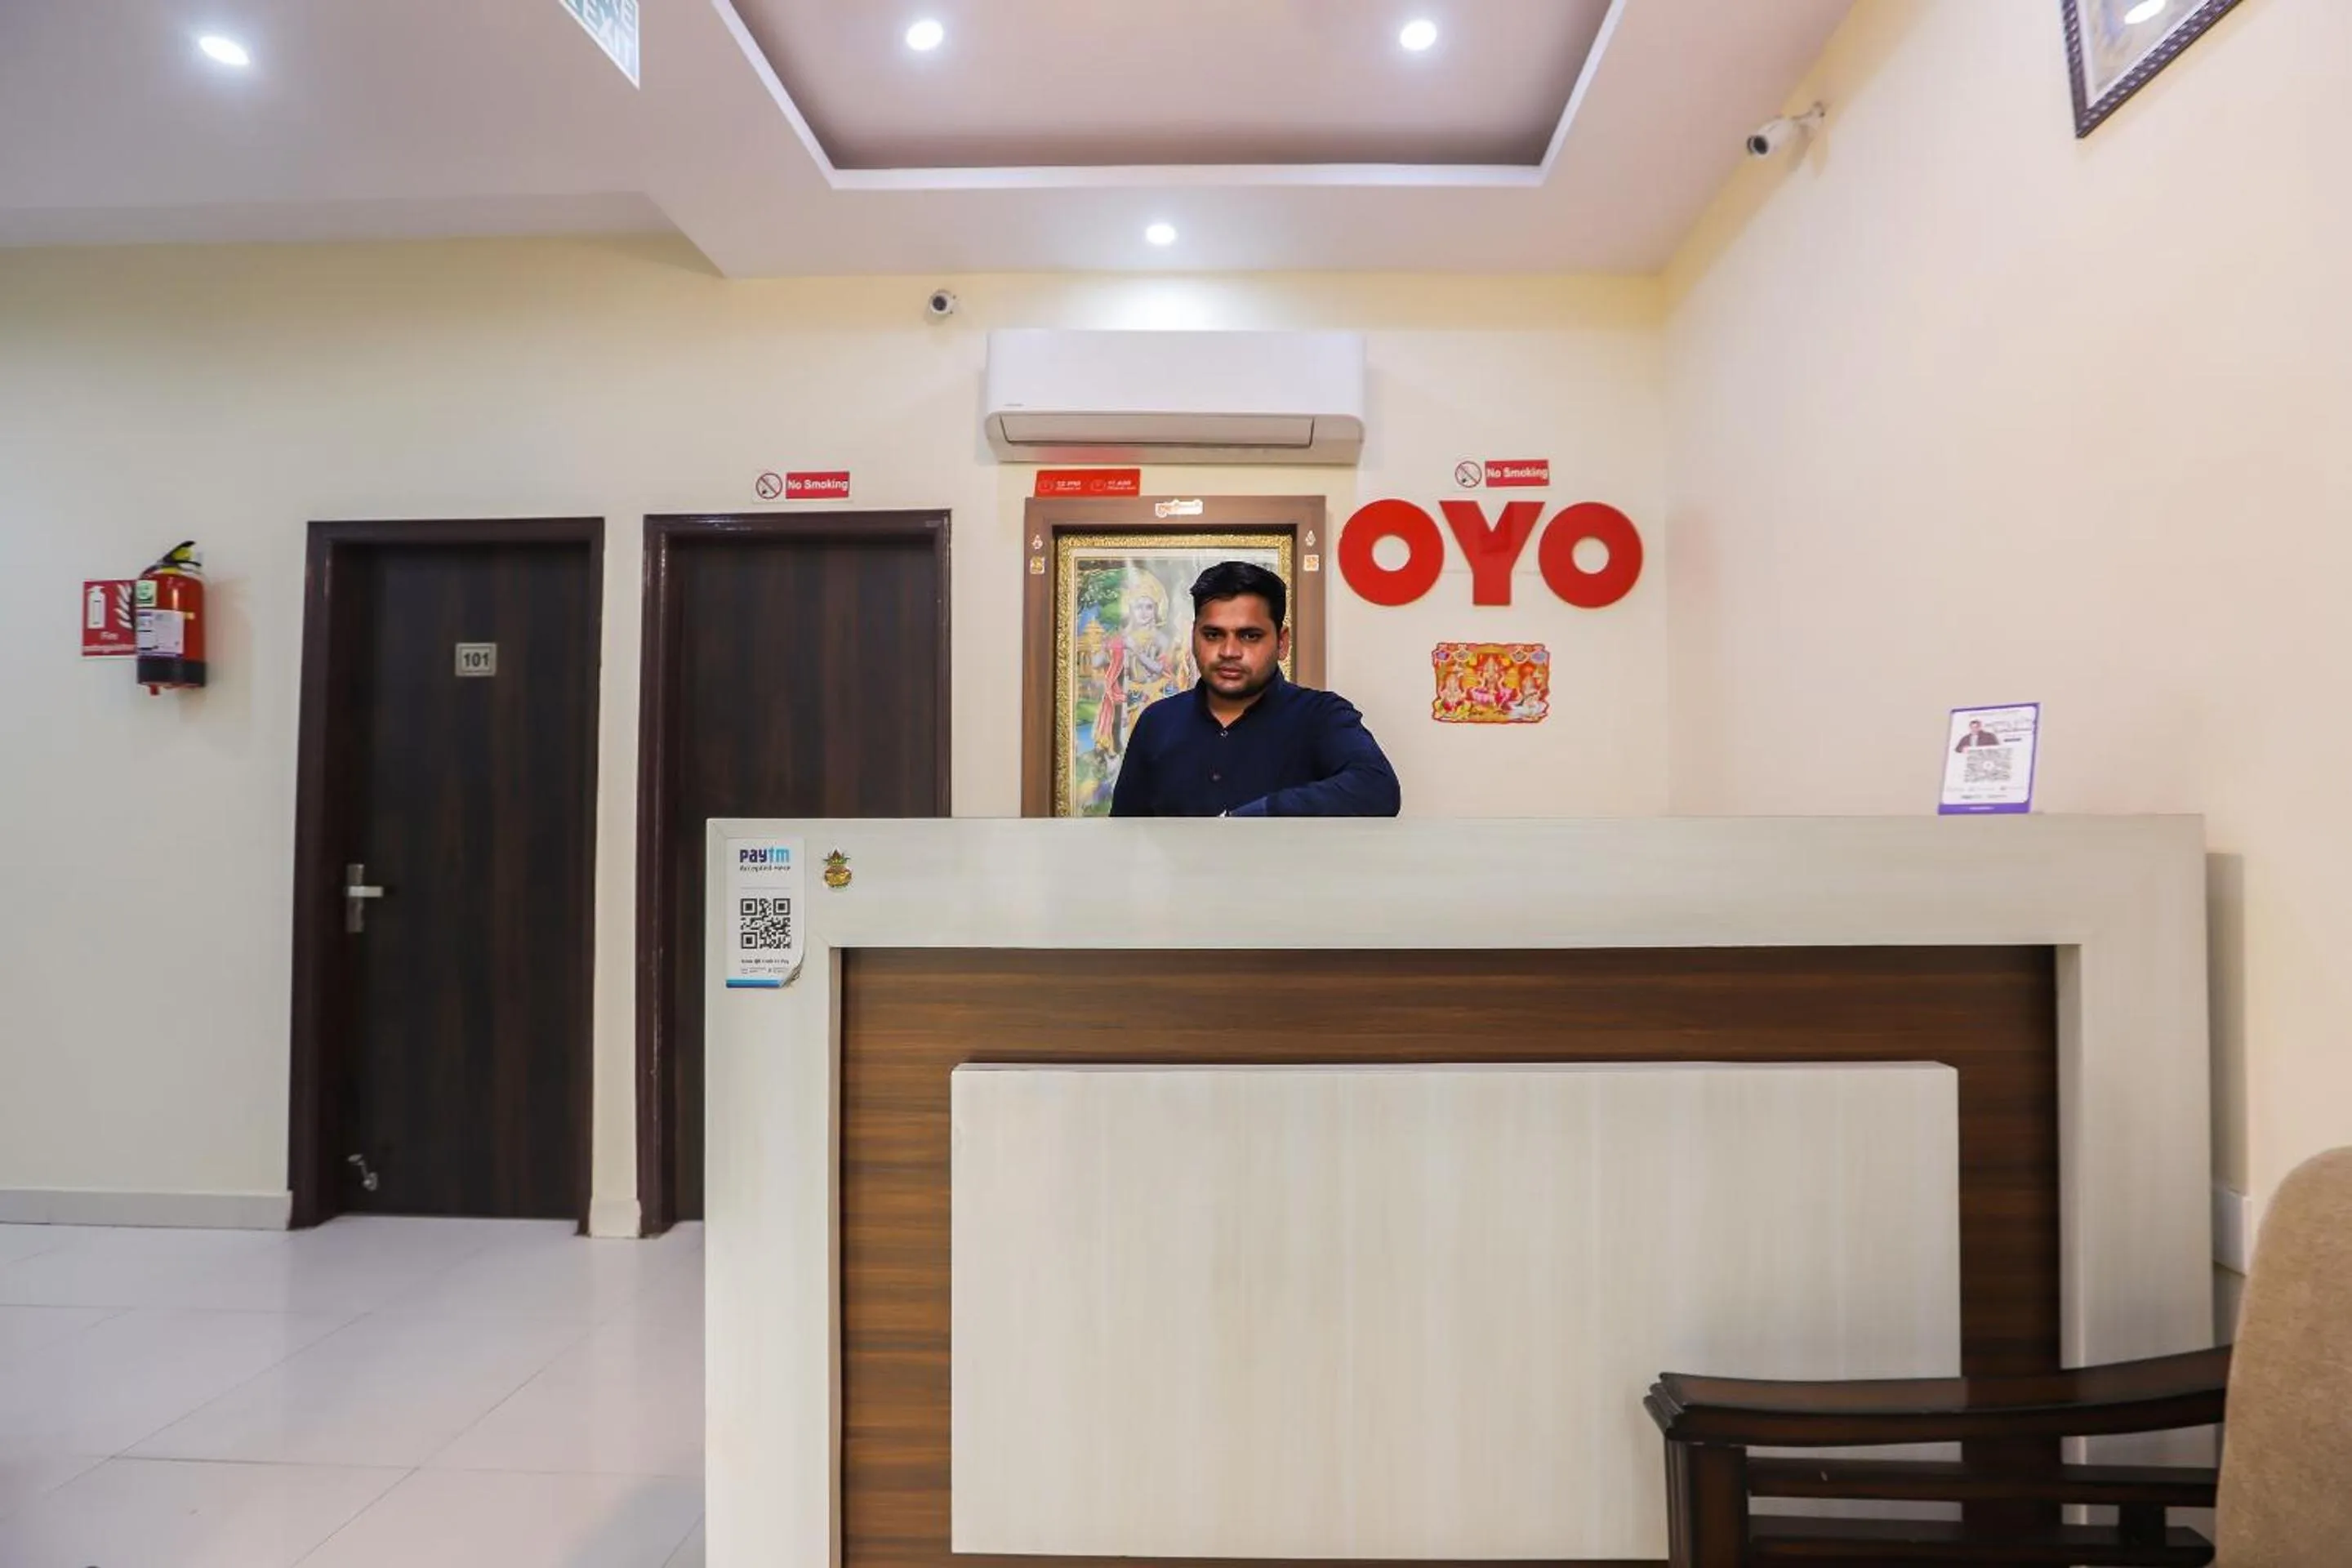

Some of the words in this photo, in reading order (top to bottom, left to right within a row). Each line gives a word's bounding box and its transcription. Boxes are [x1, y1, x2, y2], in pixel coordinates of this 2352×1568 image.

[1486, 468, 1501, 478] No
[1503, 466, 1548, 480] Smoking
[788, 479, 802, 489] No
[804, 479, 849, 492] Smoking
[1338, 498, 1643, 608] OYO
[463, 652, 489, 667] 101
